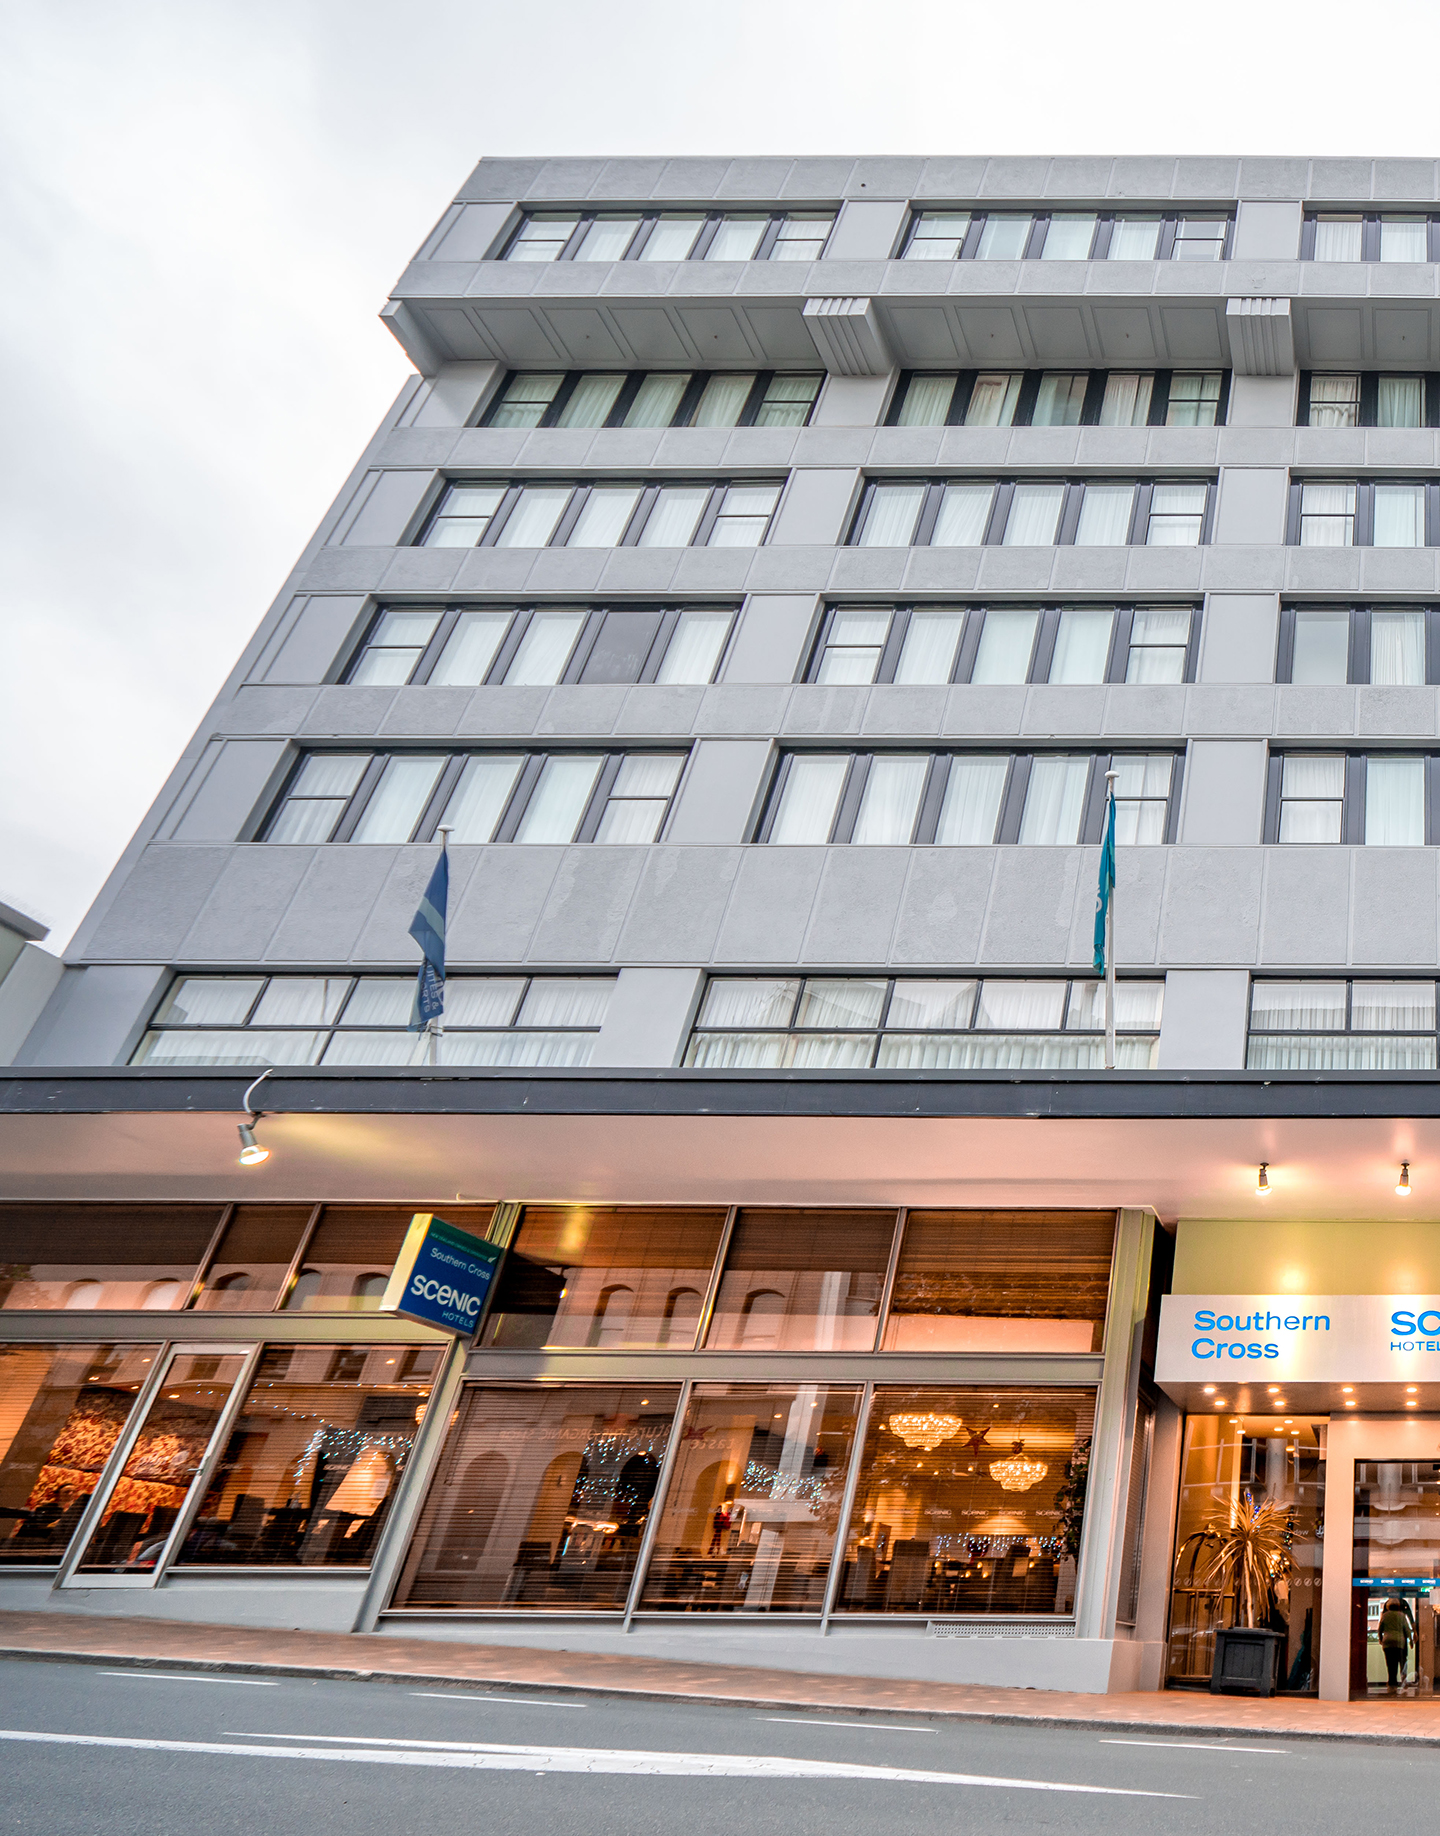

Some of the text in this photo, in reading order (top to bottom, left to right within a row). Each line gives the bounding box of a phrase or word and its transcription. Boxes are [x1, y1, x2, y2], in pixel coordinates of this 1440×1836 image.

[430, 1247, 491, 1281] Southern Cross
[441, 1310, 474, 1328] HOTELS
[1193, 1309, 1331, 1332] Southern
[1191, 1337, 1280, 1360] Cross
